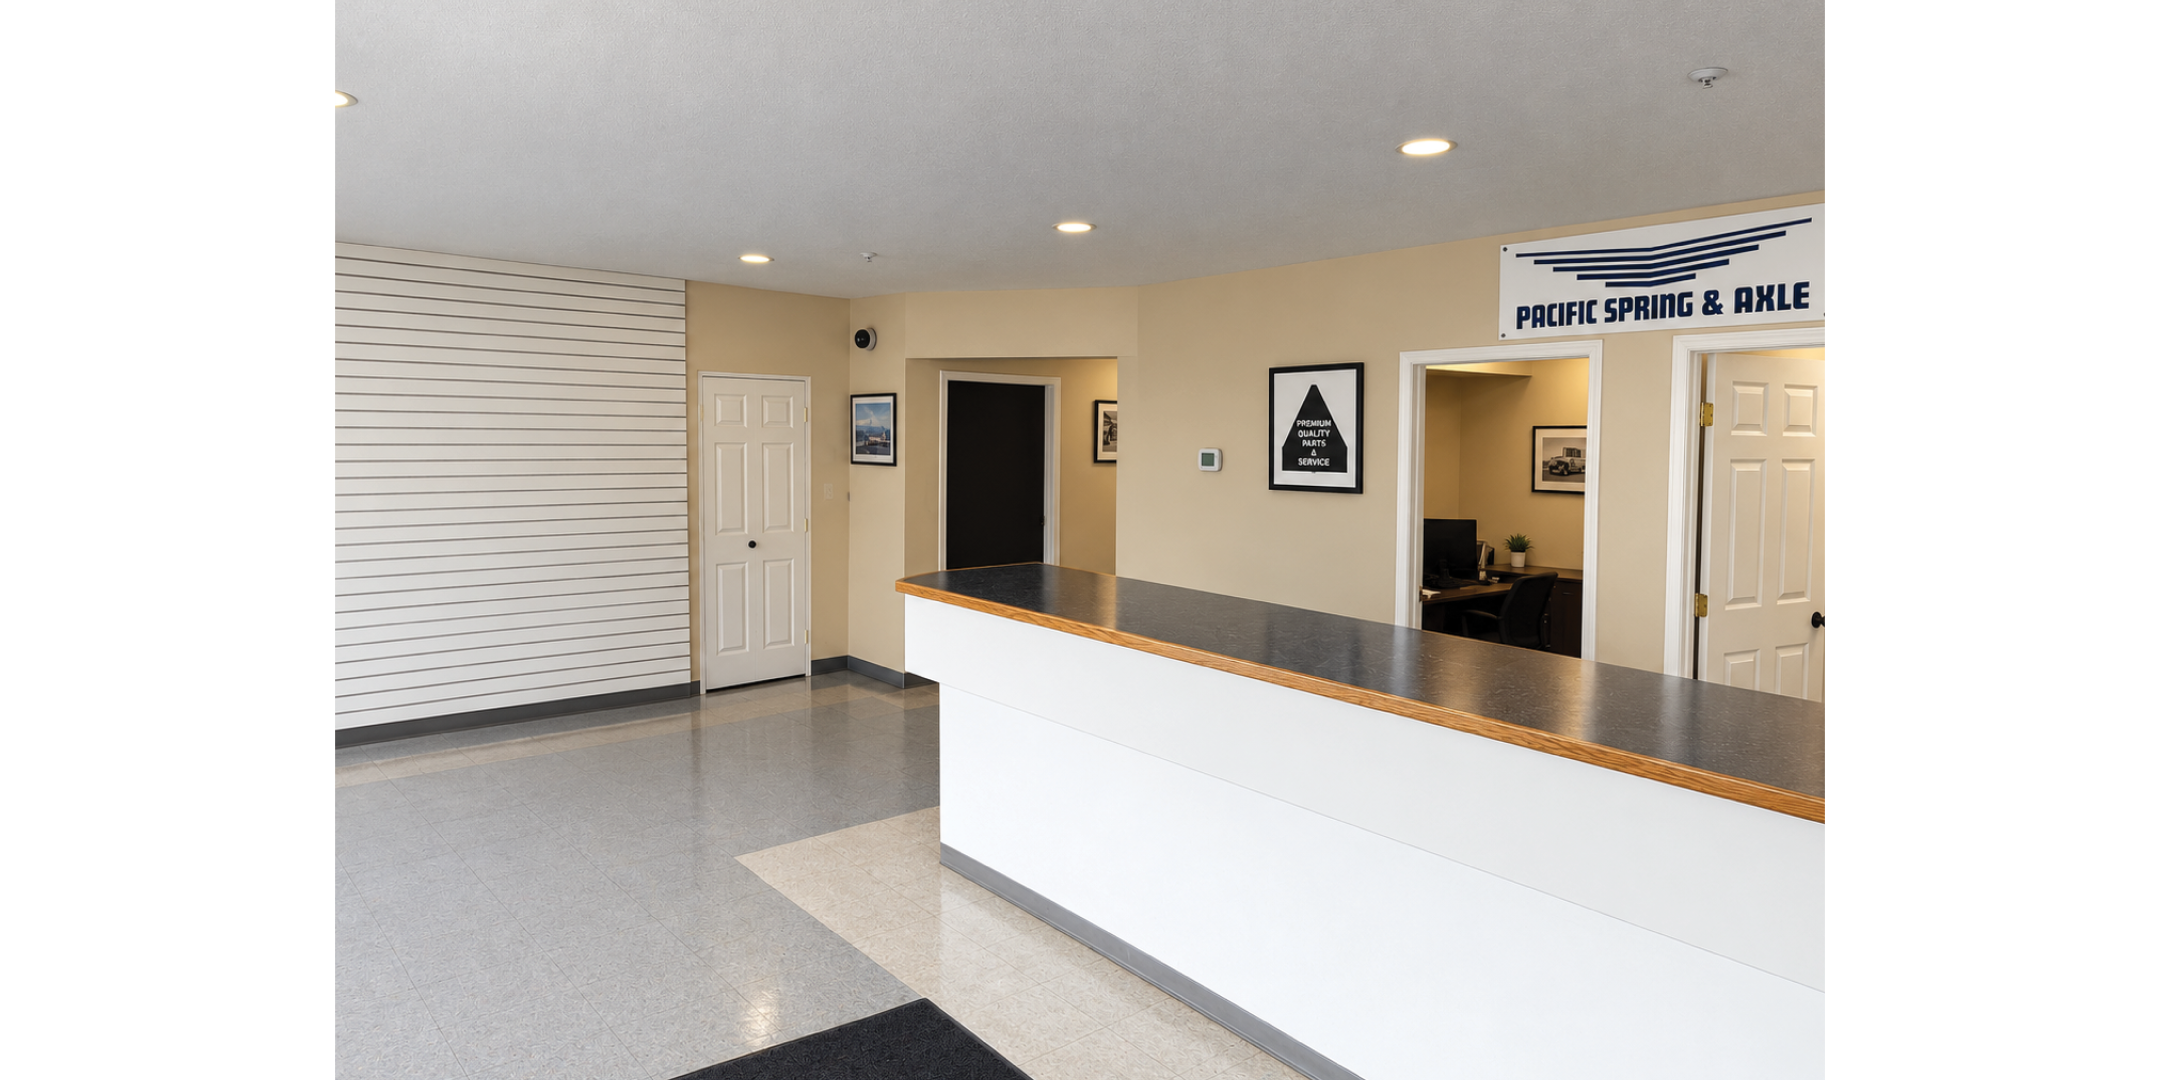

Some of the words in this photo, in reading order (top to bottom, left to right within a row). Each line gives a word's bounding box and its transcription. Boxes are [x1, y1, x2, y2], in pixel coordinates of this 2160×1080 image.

[1516, 299, 1598, 330] PACIFIC
[1604, 291, 1694, 323] SPRING
[1702, 289, 1724, 316] &
[1734, 281, 1810, 315] AXLE
[1296, 419, 1332, 428] PREMIUM
[1297, 429, 1331, 438] QUALITY
[1302, 439, 1327, 447] PARTS
[1298, 457, 1330, 467] SERVICE
